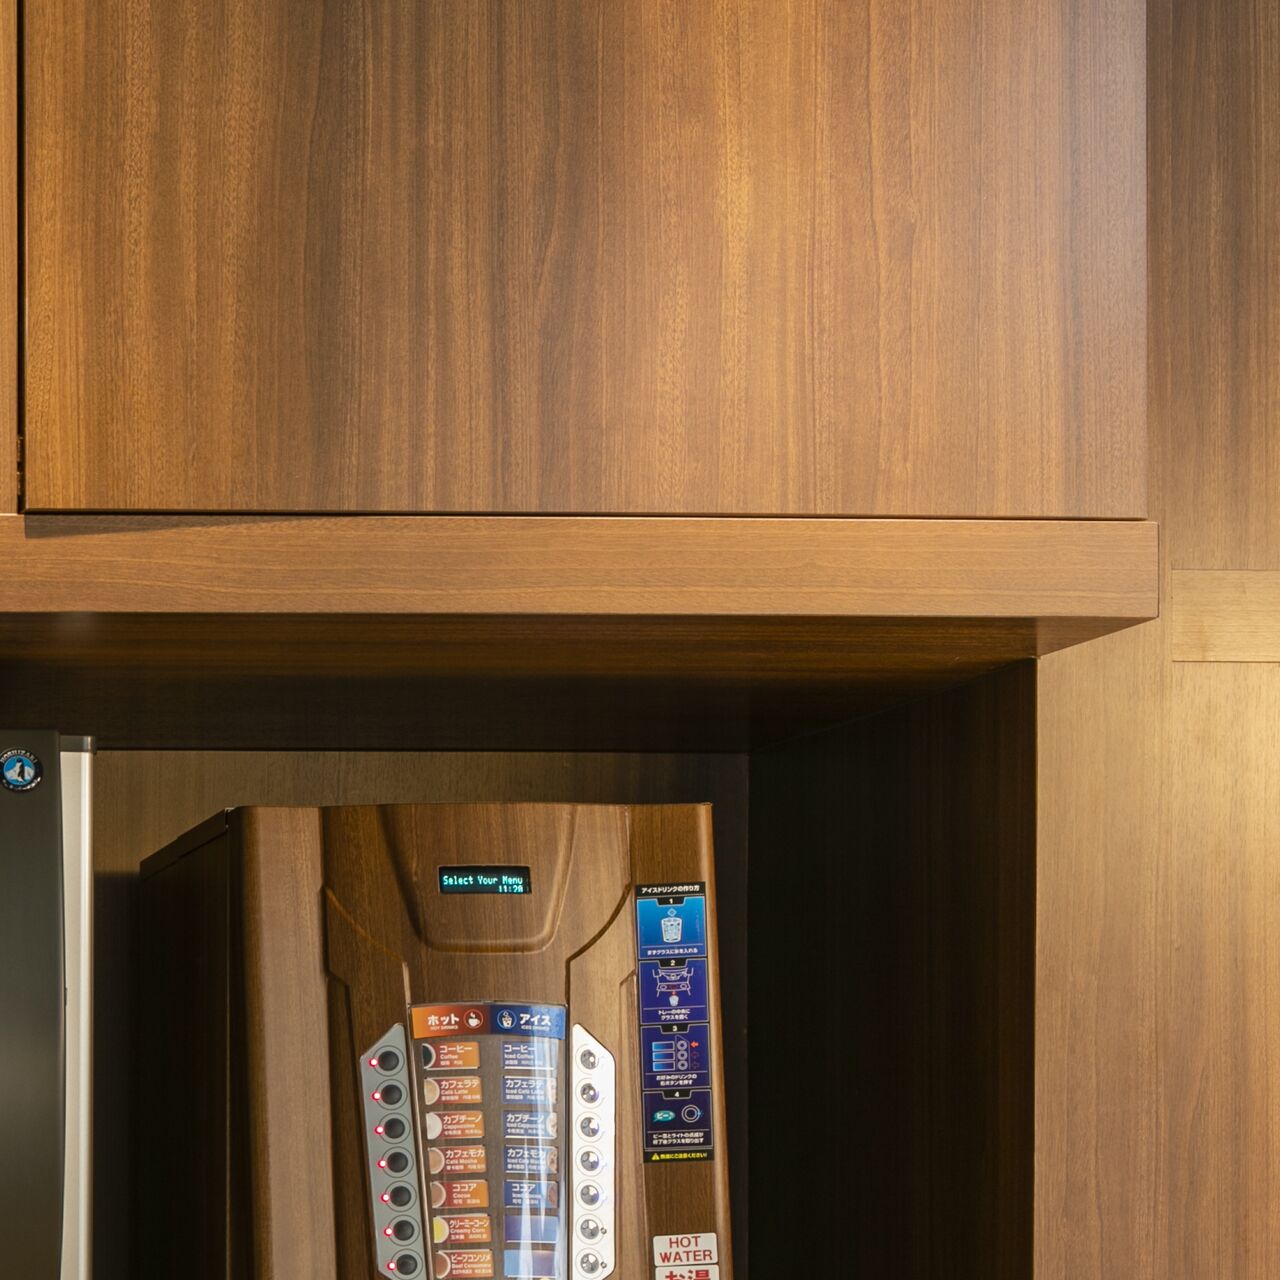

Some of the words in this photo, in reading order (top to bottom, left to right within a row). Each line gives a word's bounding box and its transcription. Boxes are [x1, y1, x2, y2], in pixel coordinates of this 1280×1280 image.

[443, 876, 473, 885] Select
[478, 876, 498, 885] Your
[502, 876, 523, 885] Menu
[642, 885, 700, 893] アイスドリンクの作り方
[427, 1014, 459, 1026] ホット
[520, 1014, 551, 1026] アイス
[440, 1045, 472, 1053] コーヒー
[504, 1045, 536, 1053] コーヒー
[441, 1080, 479, 1088] カフェラテ
[506, 1080, 544, 1088] カフェラテ
[446, 1150, 485, 1158] カフェモカ
[453, 1184, 477, 1192] ココア
[512, 1184, 536, 1192] ココア
[450, 1220, 488, 1228] クリーミーコーン
[669, 1235, 701, 1249] HOT
[451, 1254, 491, 1262] ビーフコンソメ
[660, 1249, 712, 1264] WATER
